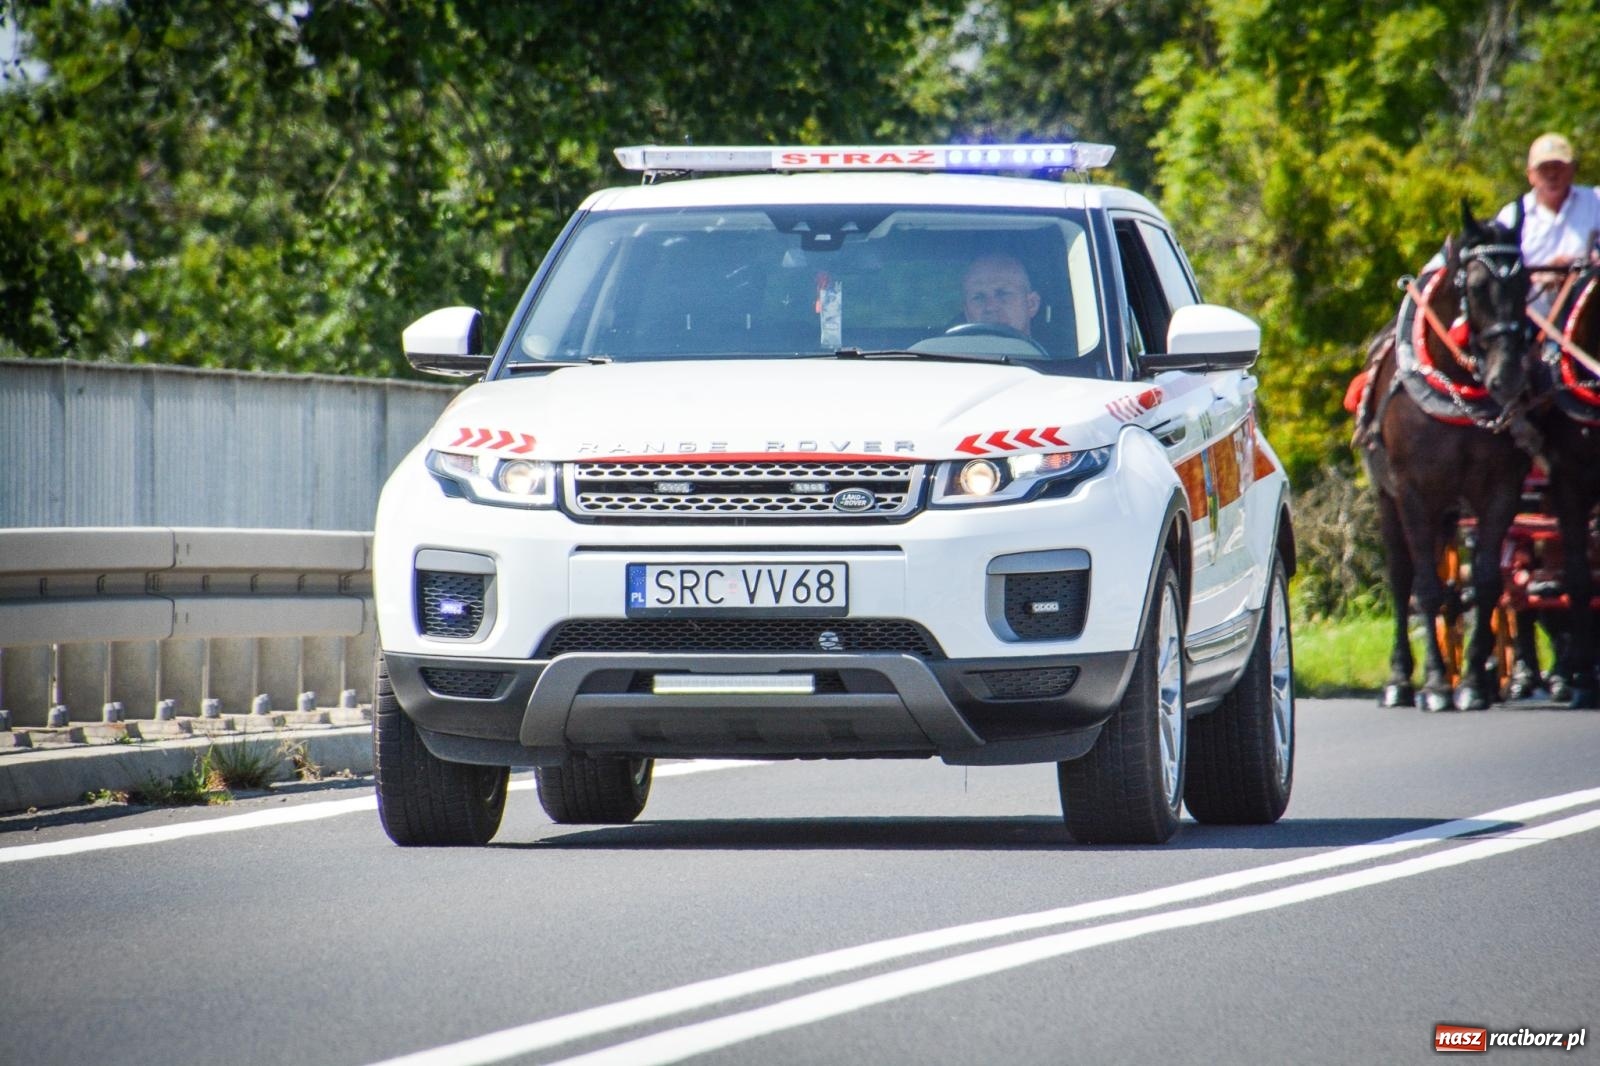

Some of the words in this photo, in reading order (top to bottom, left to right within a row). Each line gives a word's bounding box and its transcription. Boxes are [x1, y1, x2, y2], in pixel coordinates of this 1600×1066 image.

[782, 150, 935, 165] STRAŻ
[578, 442, 728, 453] RANGE
[767, 440, 915, 452] ROVER
[655, 569, 725, 604] SRC
[742, 569, 835, 605] VV68
[631, 592, 645, 603] PL
